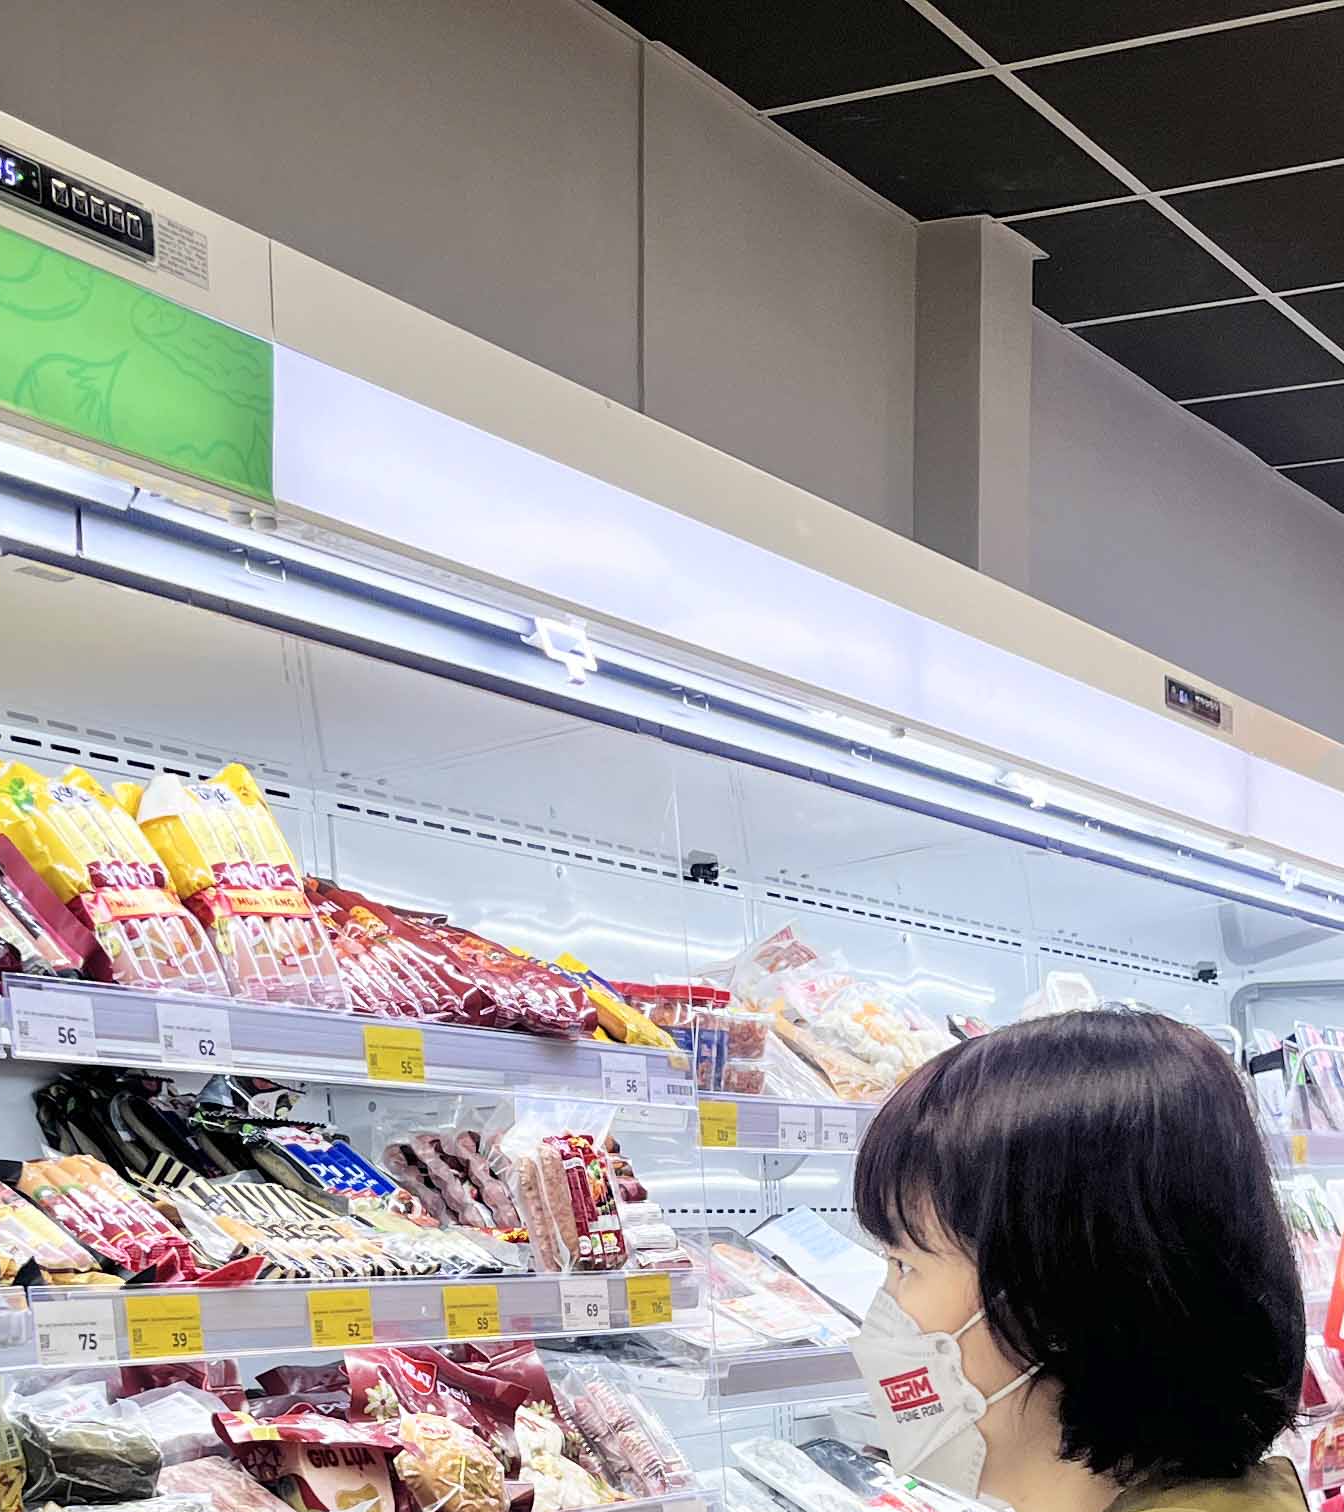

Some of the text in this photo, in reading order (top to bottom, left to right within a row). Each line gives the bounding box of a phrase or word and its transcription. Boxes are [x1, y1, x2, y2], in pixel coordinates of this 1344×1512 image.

[57, 1027, 78, 1046] 56
[198, 1039, 216, 1057] 62
[401, 1061, 414, 1076] 55
[586, 1303, 599, 1318] 69
[348, 1322, 361, 1337] 52
[78, 1333, 98, 1351] 75
[171, 1332, 188, 1349] 39
